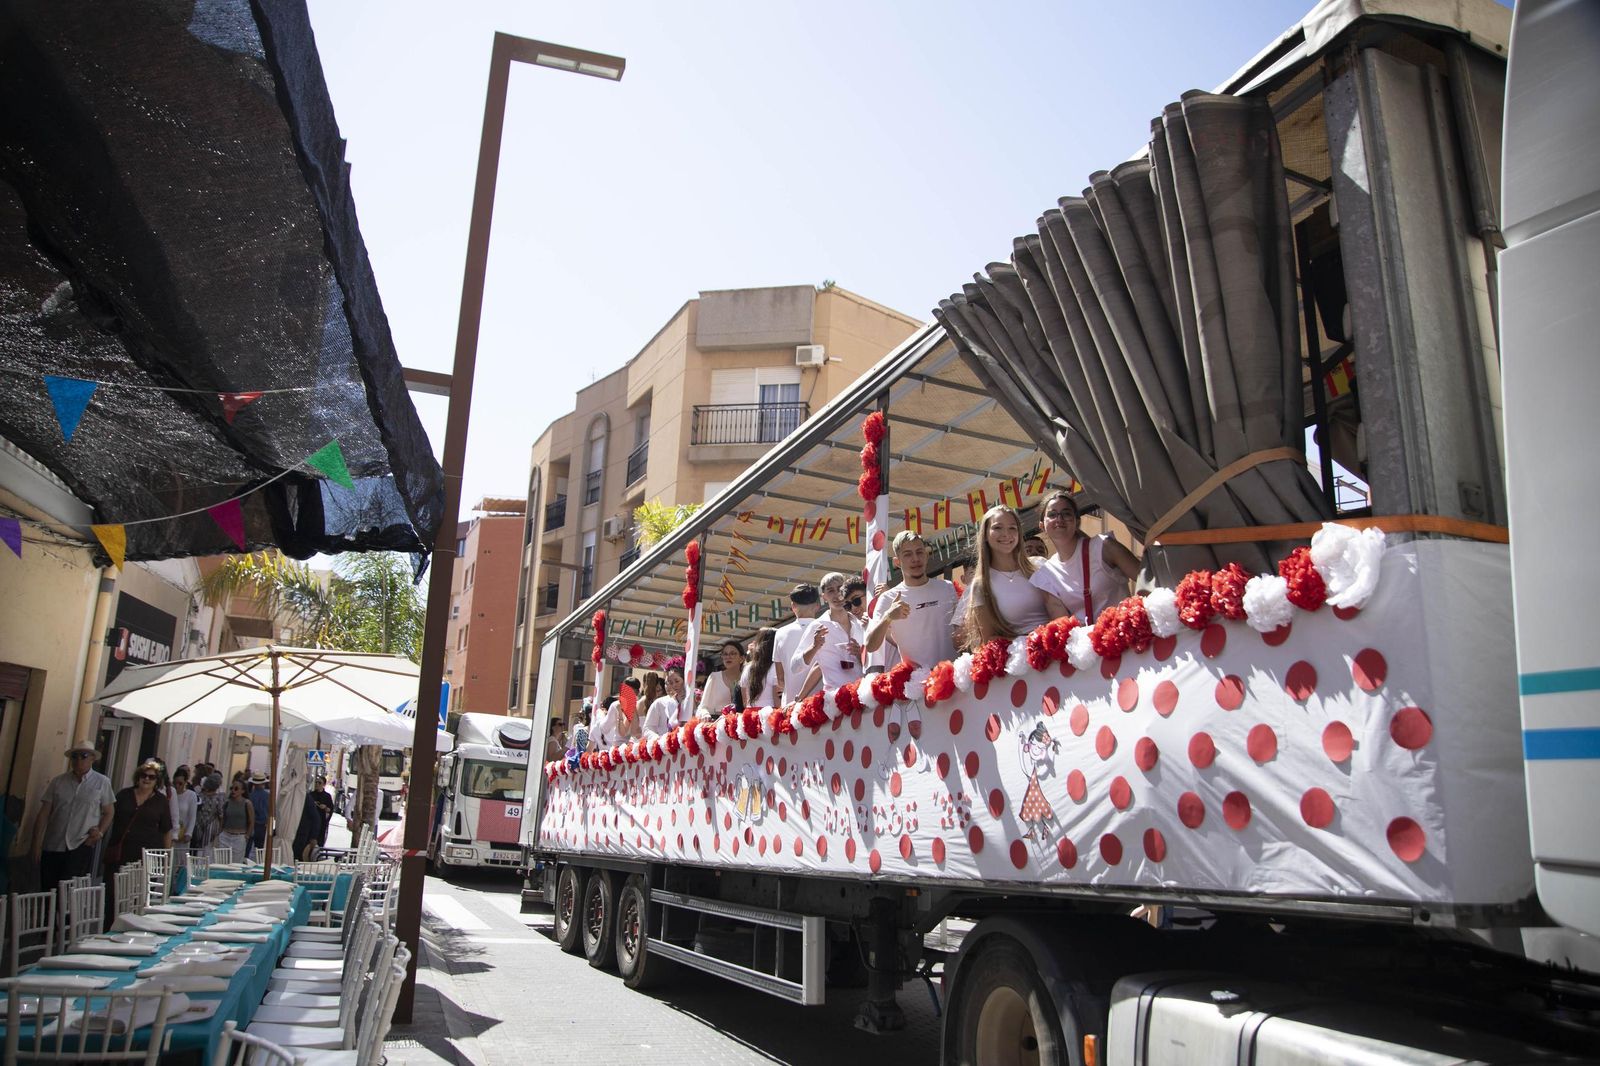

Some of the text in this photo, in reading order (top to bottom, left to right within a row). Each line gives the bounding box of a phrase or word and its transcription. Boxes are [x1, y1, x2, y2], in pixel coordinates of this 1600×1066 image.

[128, 632, 151, 661] SUSHI
[507, 807, 520, 816] 49
[823, 800, 918, 836] MARCOS
